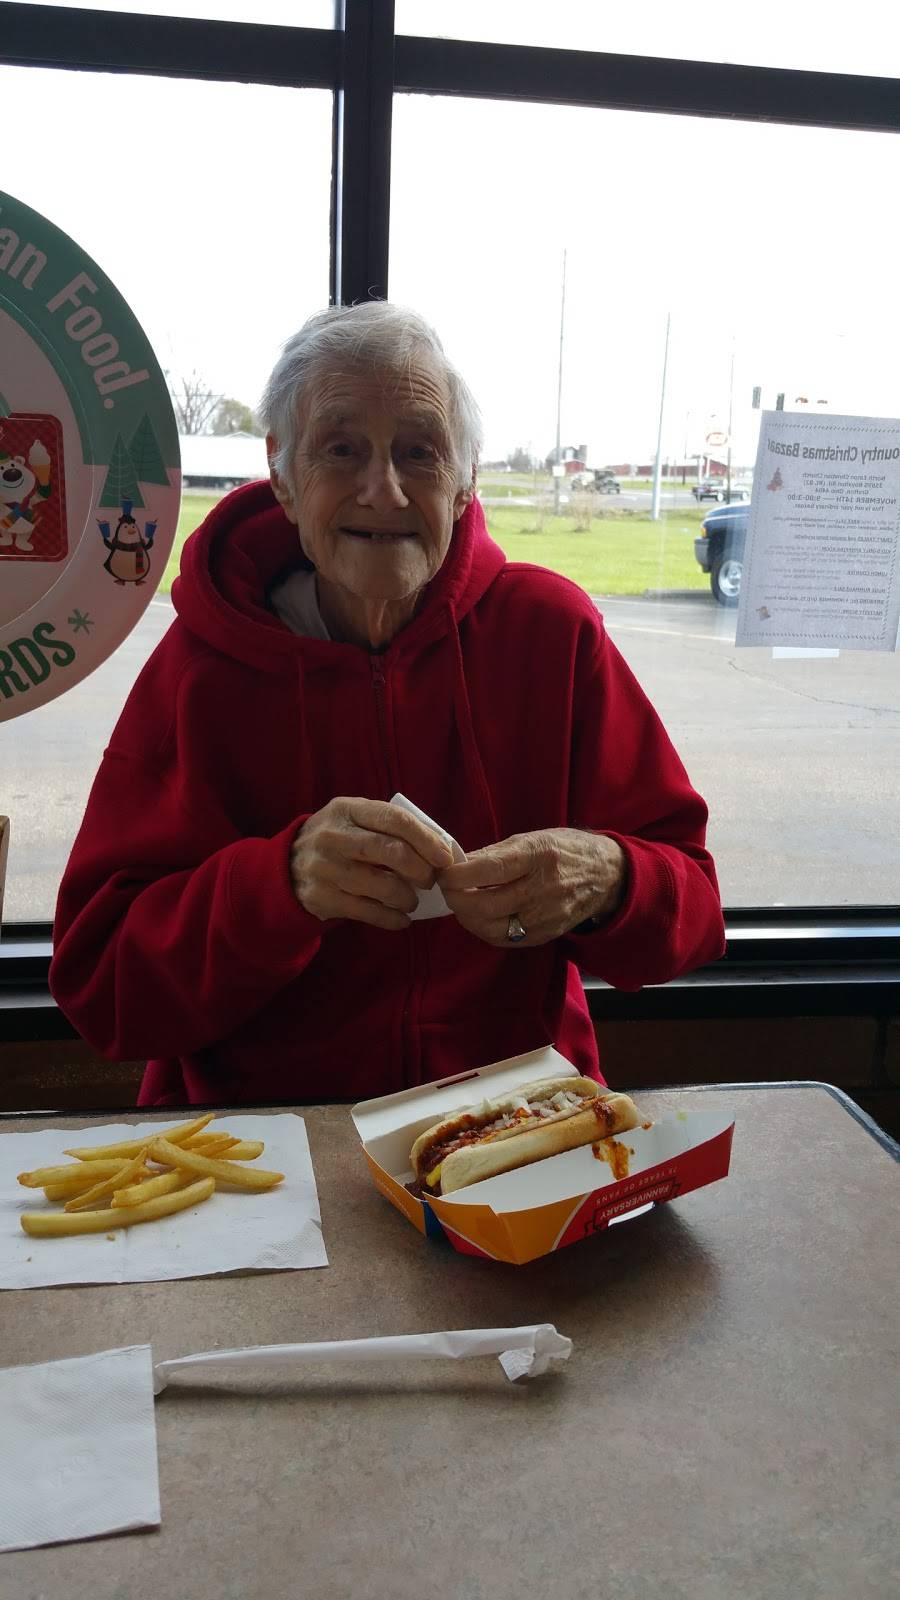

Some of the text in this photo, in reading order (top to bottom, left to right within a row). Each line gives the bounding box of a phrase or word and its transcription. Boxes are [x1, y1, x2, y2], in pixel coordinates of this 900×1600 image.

[0, 228, 150, 410] an Food.
[0, 622, 76, 699] RDS
